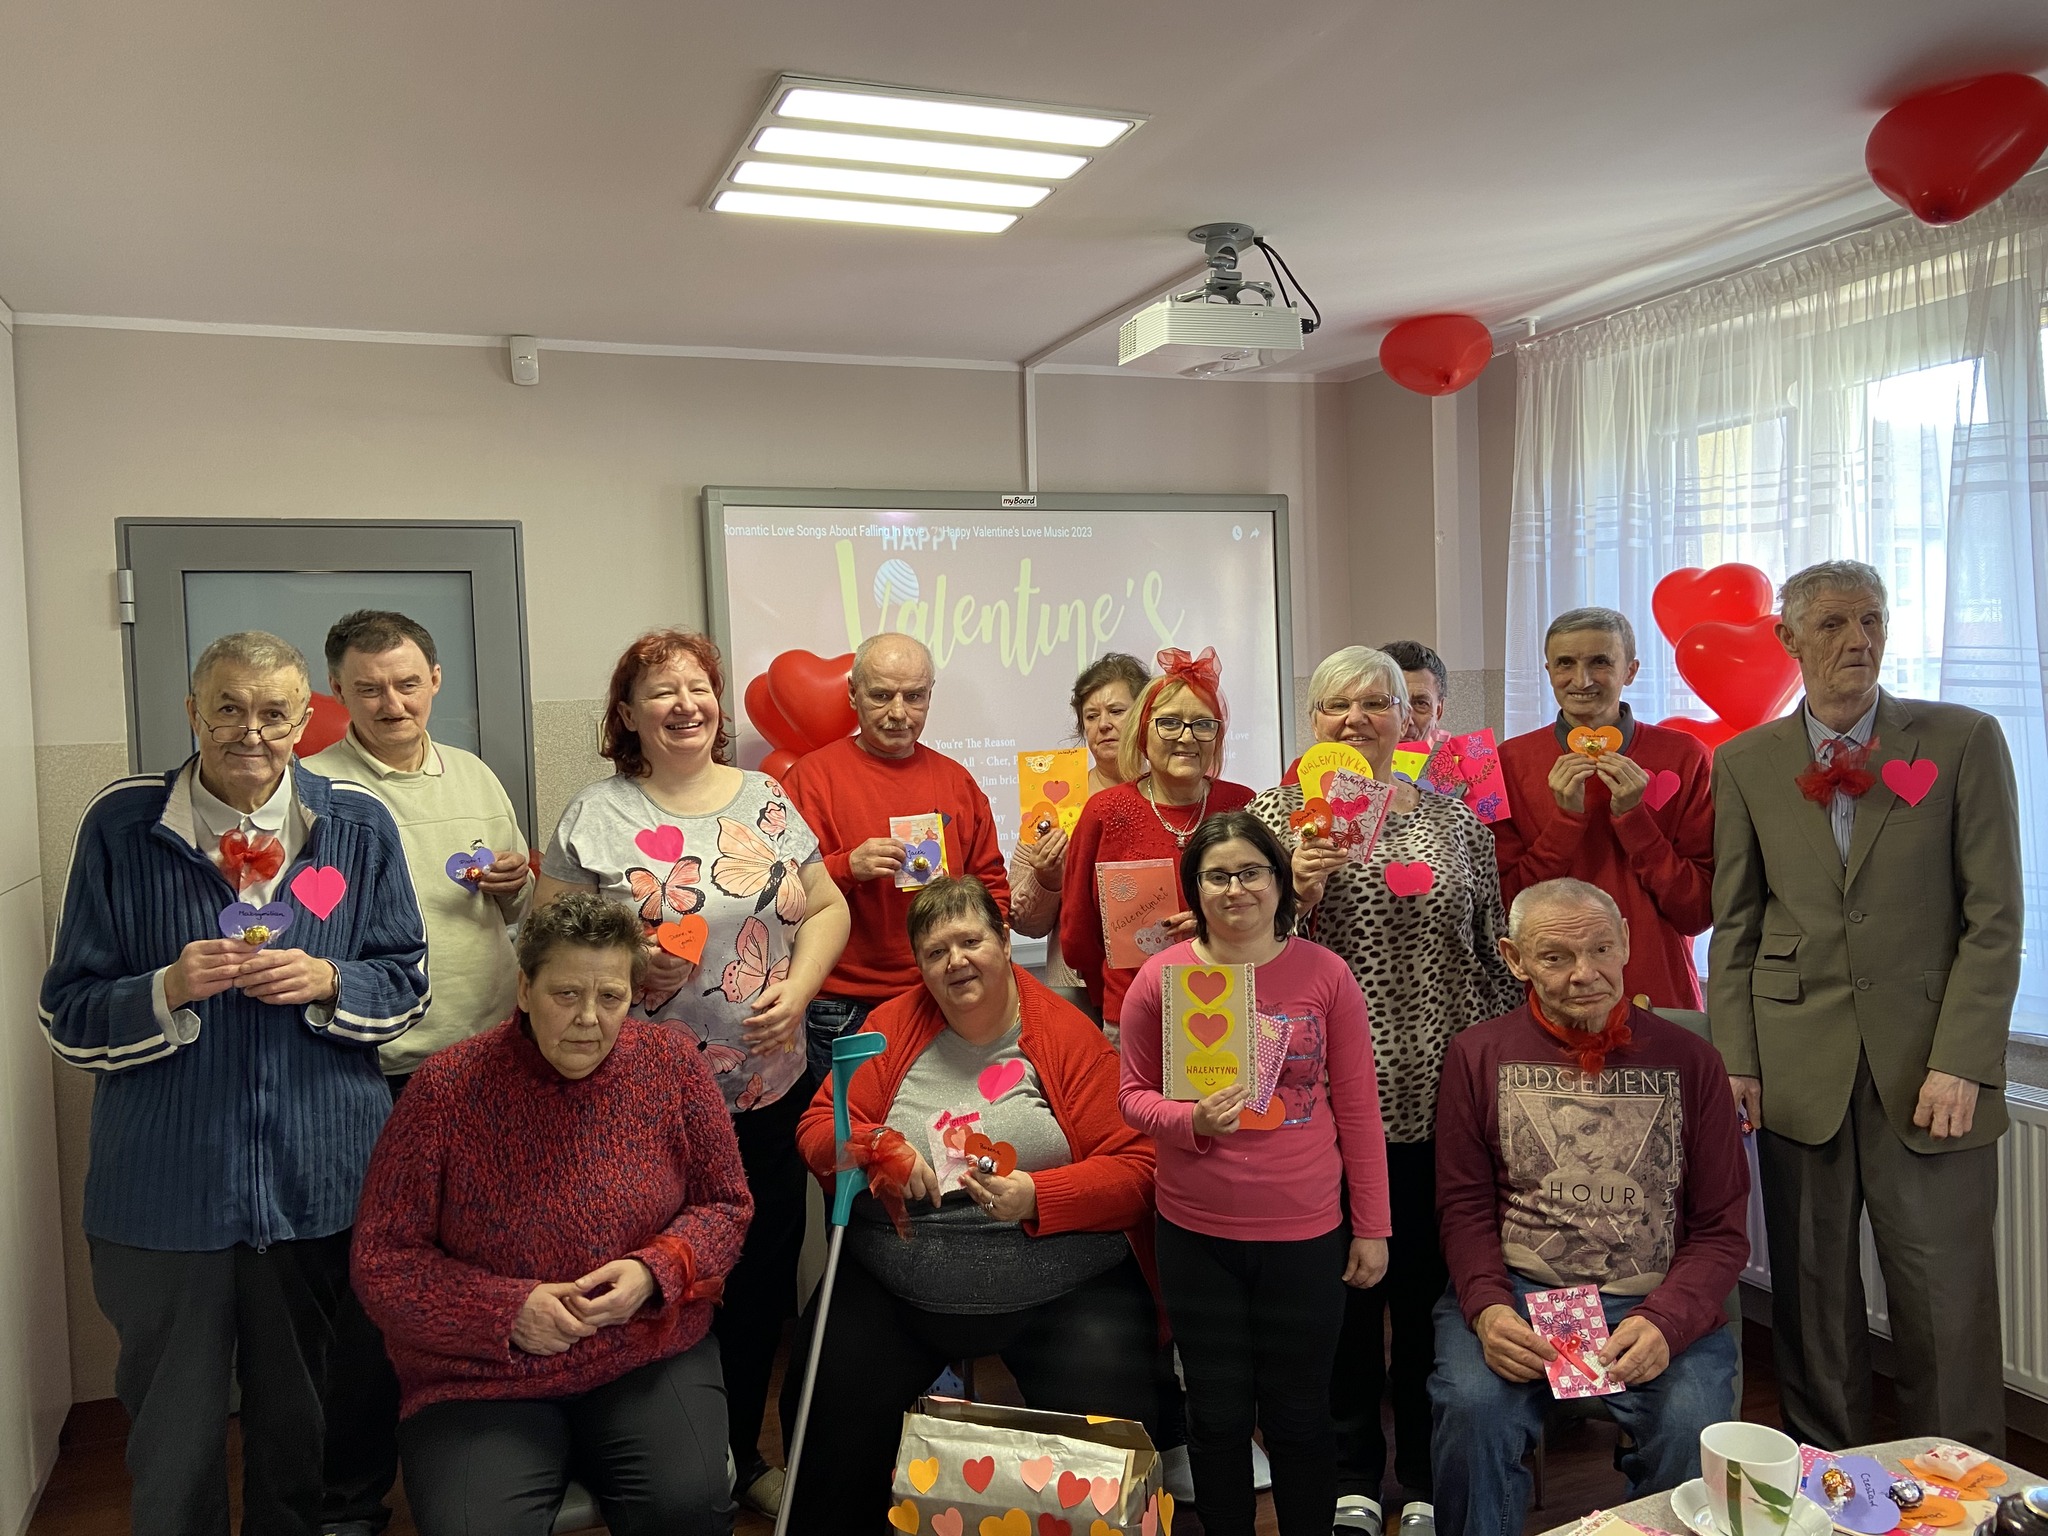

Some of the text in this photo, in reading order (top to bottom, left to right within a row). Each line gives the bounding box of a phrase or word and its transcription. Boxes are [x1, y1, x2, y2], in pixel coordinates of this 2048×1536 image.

[1003, 496, 1036, 506] myBoard
[724, 524, 1093, 540] Romantic Love Songs About Falling In Love Happy Valentine's Love Music 2023
[881, 526, 960, 551] HAPPY
[935, 739, 964, 749] You're
[965, 738, 982, 748] The
[984, 738, 1016, 748] Reason
[1230, 731, 1250, 740] Love
[986, 756, 1011, 767] Cher,
[1300, 751, 1368, 776] WALENTYNKA
[1110, 886, 1169, 933] Walentynki
[1505, 1066, 1676, 1098] JUDGEMENT
